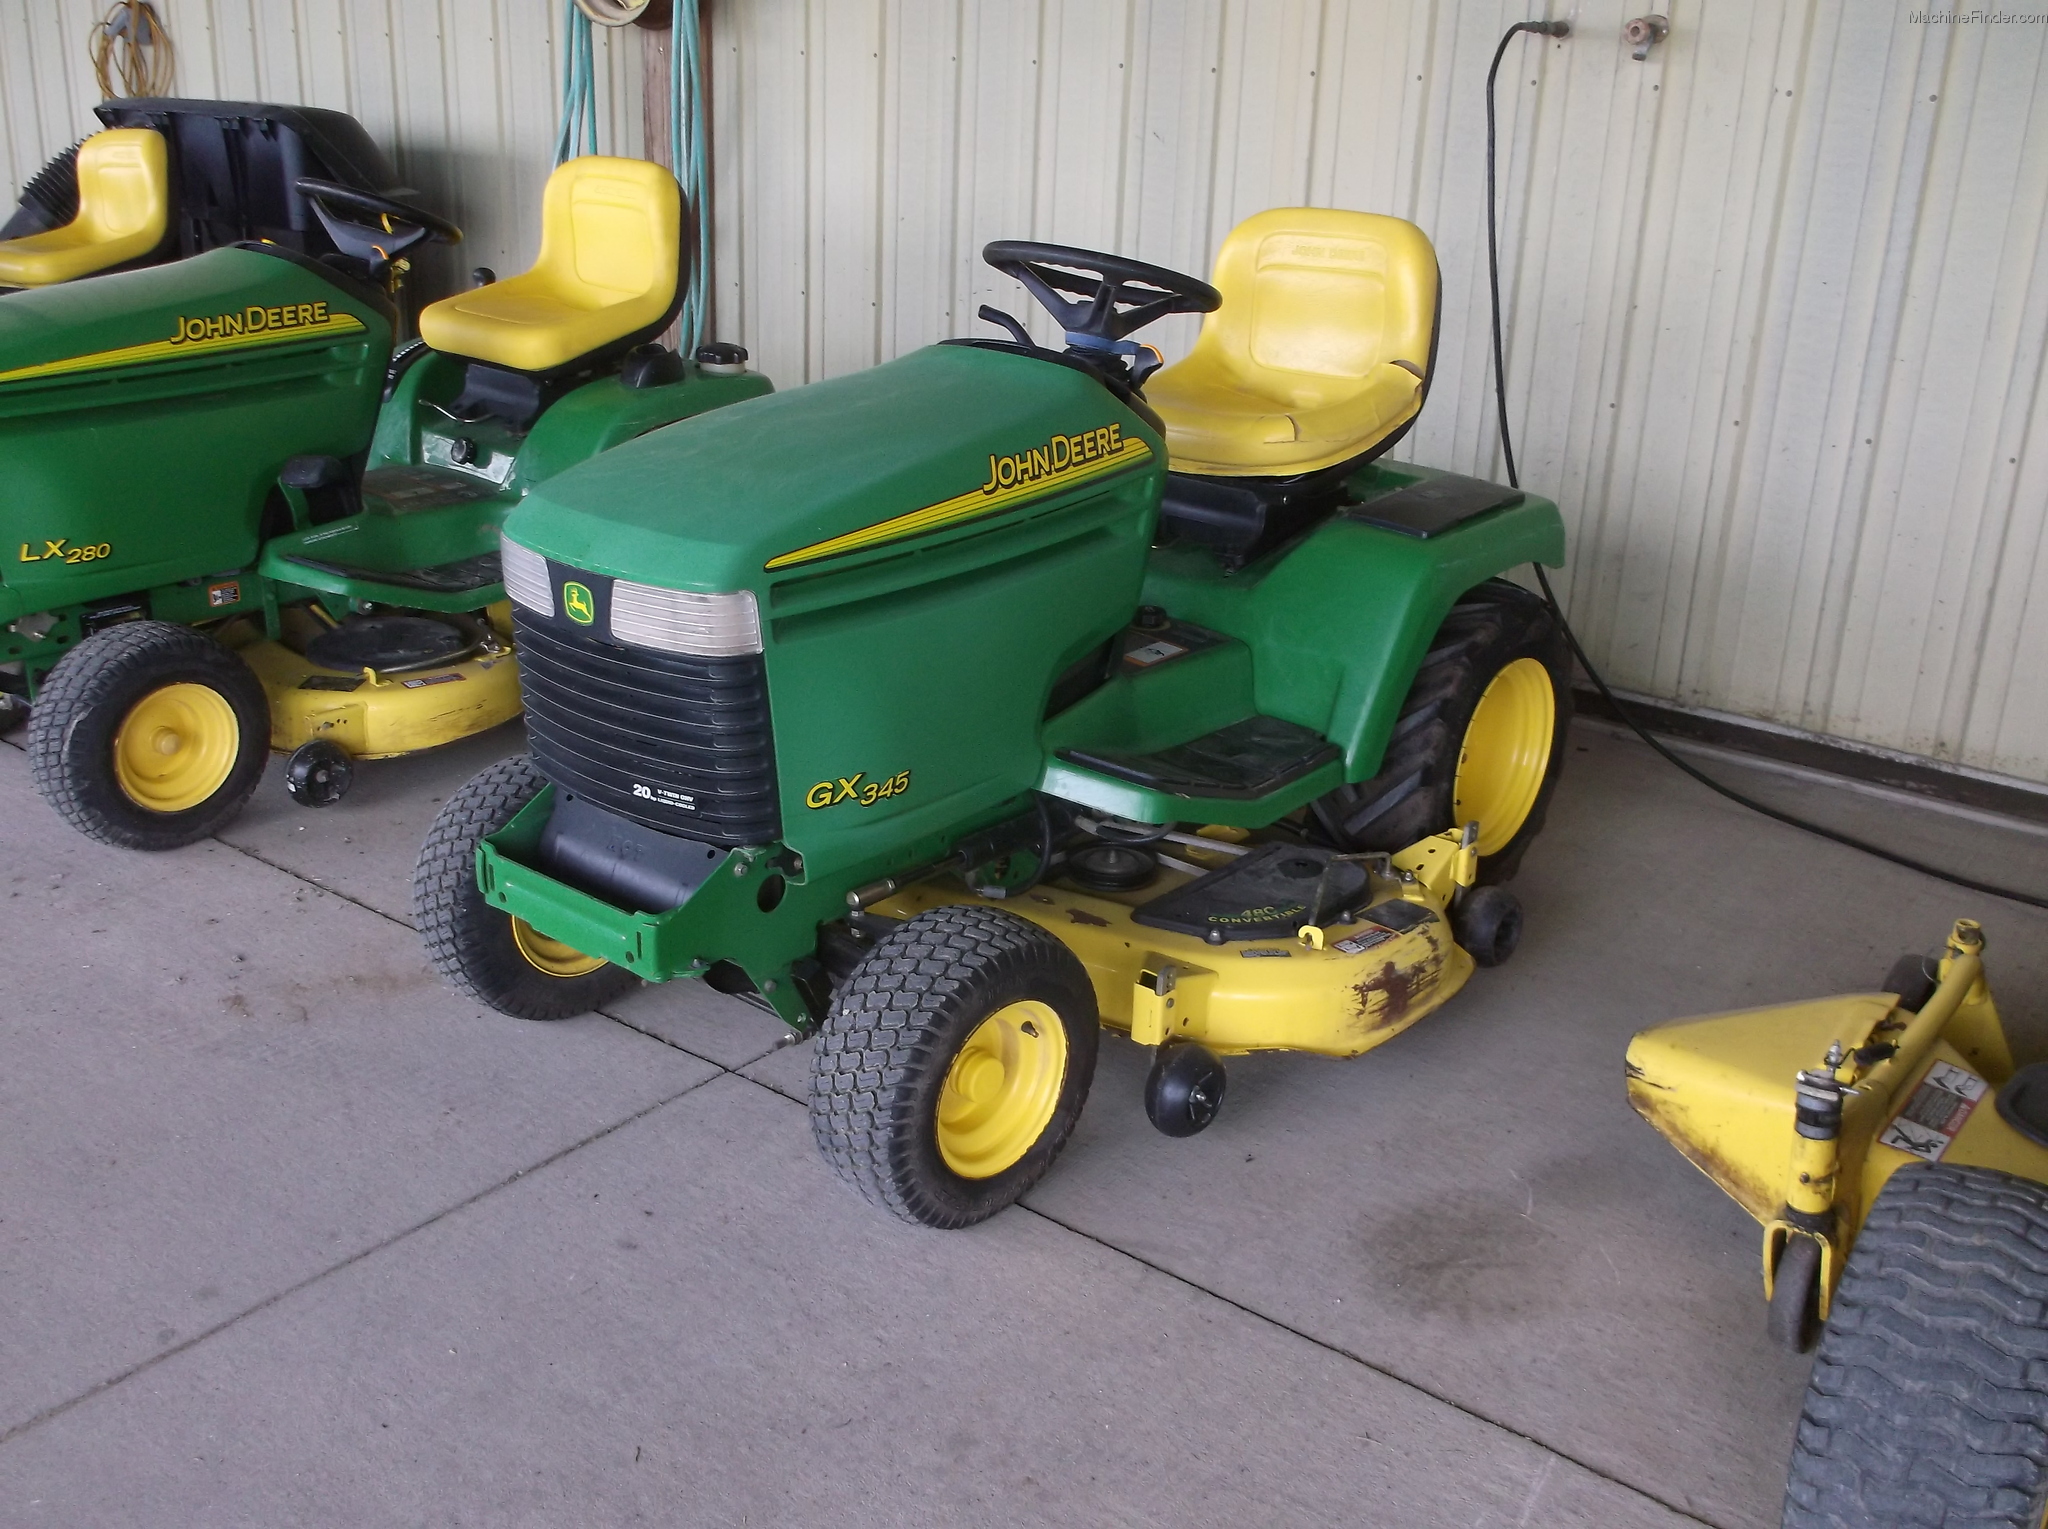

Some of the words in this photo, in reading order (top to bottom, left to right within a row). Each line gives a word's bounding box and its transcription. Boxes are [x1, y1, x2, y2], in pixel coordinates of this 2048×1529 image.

[170, 313, 244, 344] JOHN
[246, 301, 330, 332] DEERE
[983, 445, 1051, 494] JOHN
[1050, 423, 1123, 471] DEERE
